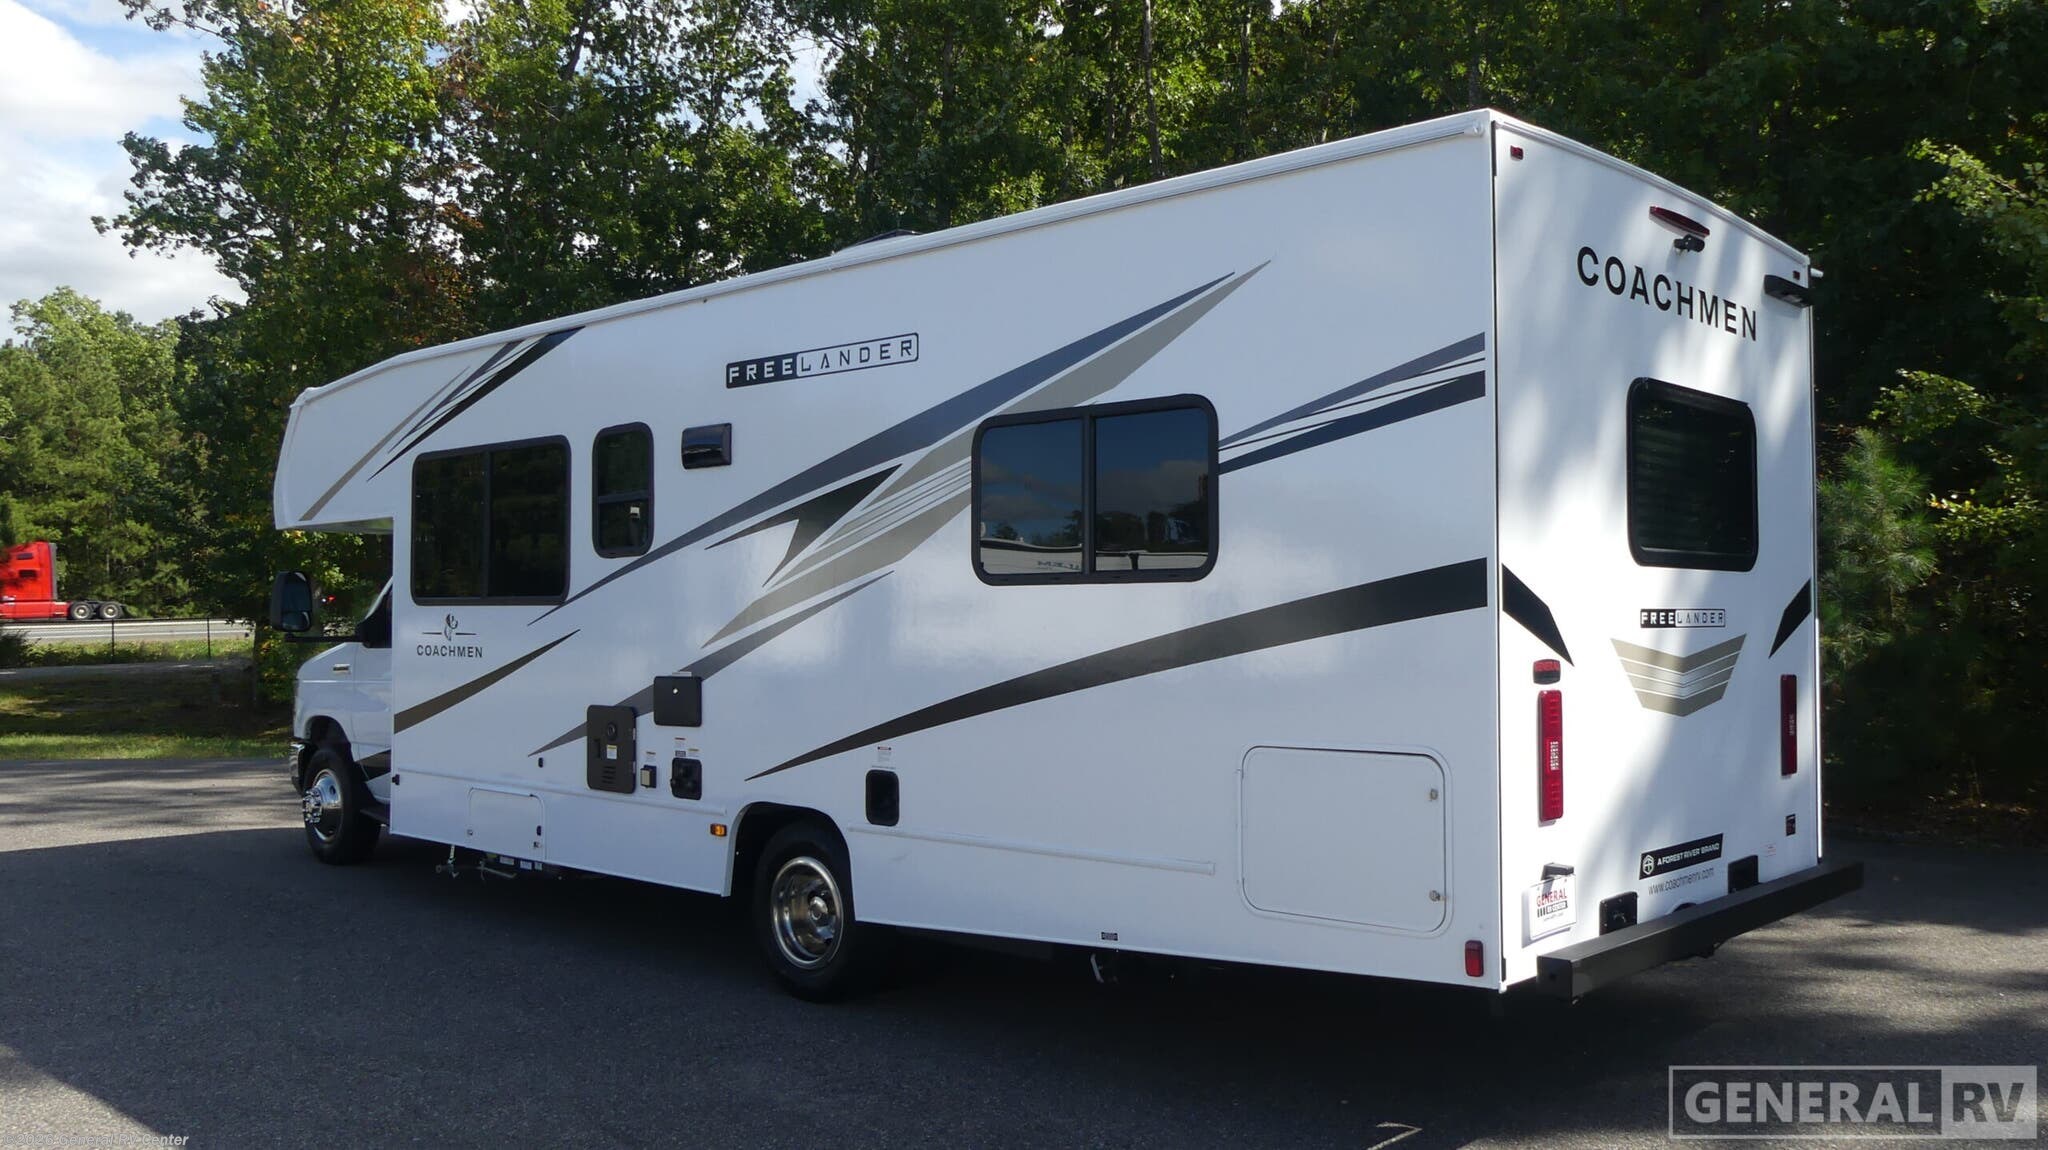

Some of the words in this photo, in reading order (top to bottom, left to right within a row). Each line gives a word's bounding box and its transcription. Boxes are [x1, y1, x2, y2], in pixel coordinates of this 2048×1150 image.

[1577, 246, 1756, 341] COACHMEN
[728, 339, 912, 384] FREELANDER
[416, 644, 484, 658] COACHMEN
[1663, 852, 1683, 864] FOREST
[1684, 848, 1700, 859] RIVER
[1701, 843, 1720, 854] BRAND
[1536, 888, 1567, 907] GENERAL
